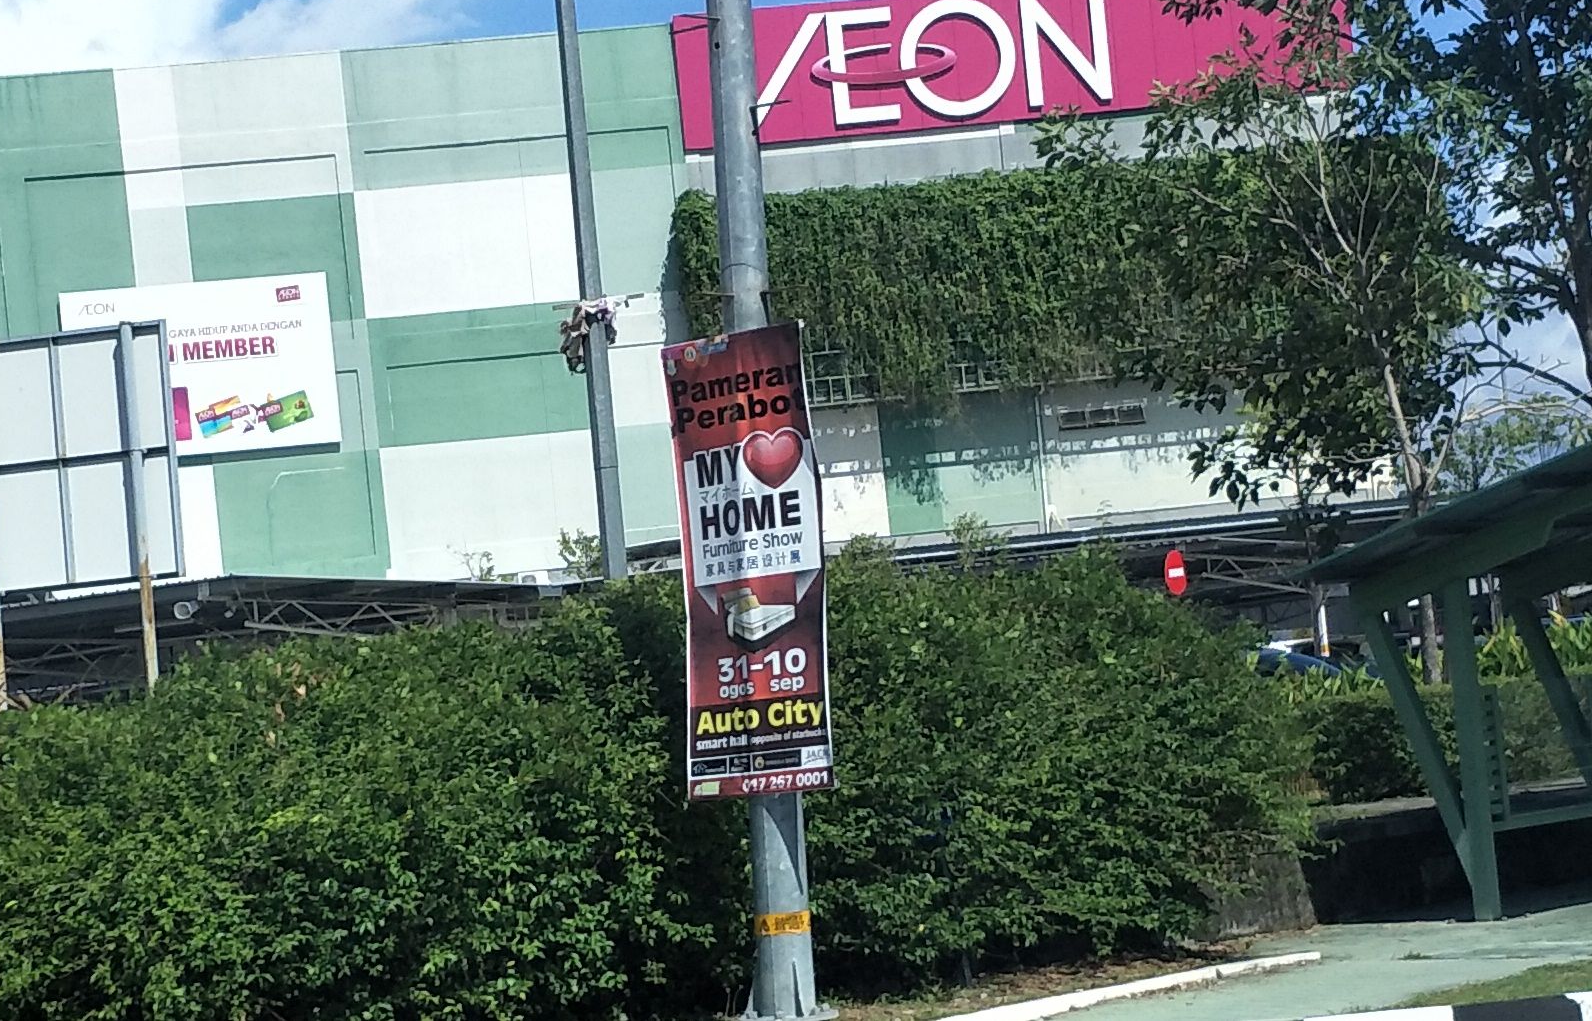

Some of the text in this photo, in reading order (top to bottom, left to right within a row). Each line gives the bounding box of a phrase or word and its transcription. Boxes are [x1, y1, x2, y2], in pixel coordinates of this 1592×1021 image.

[168, 319, 302, 338] GAYA HIDUP ANDA DENGAN
[182, 336, 275, 361] MEMBER
[671, 363, 803, 407] Pameran
[675, 387, 806, 434] Perabot
[695, 445, 742, 489] MY
[699, 489, 802, 541] HOME
[702, 531, 804, 560] Furniture Show
[719, 675, 805, 700] ogos sep
[696, 699, 824, 735] Auto City
[696, 737, 728, 751] smart
[729, 734, 748, 747] hall
[795, 770, 828, 788] 0001
